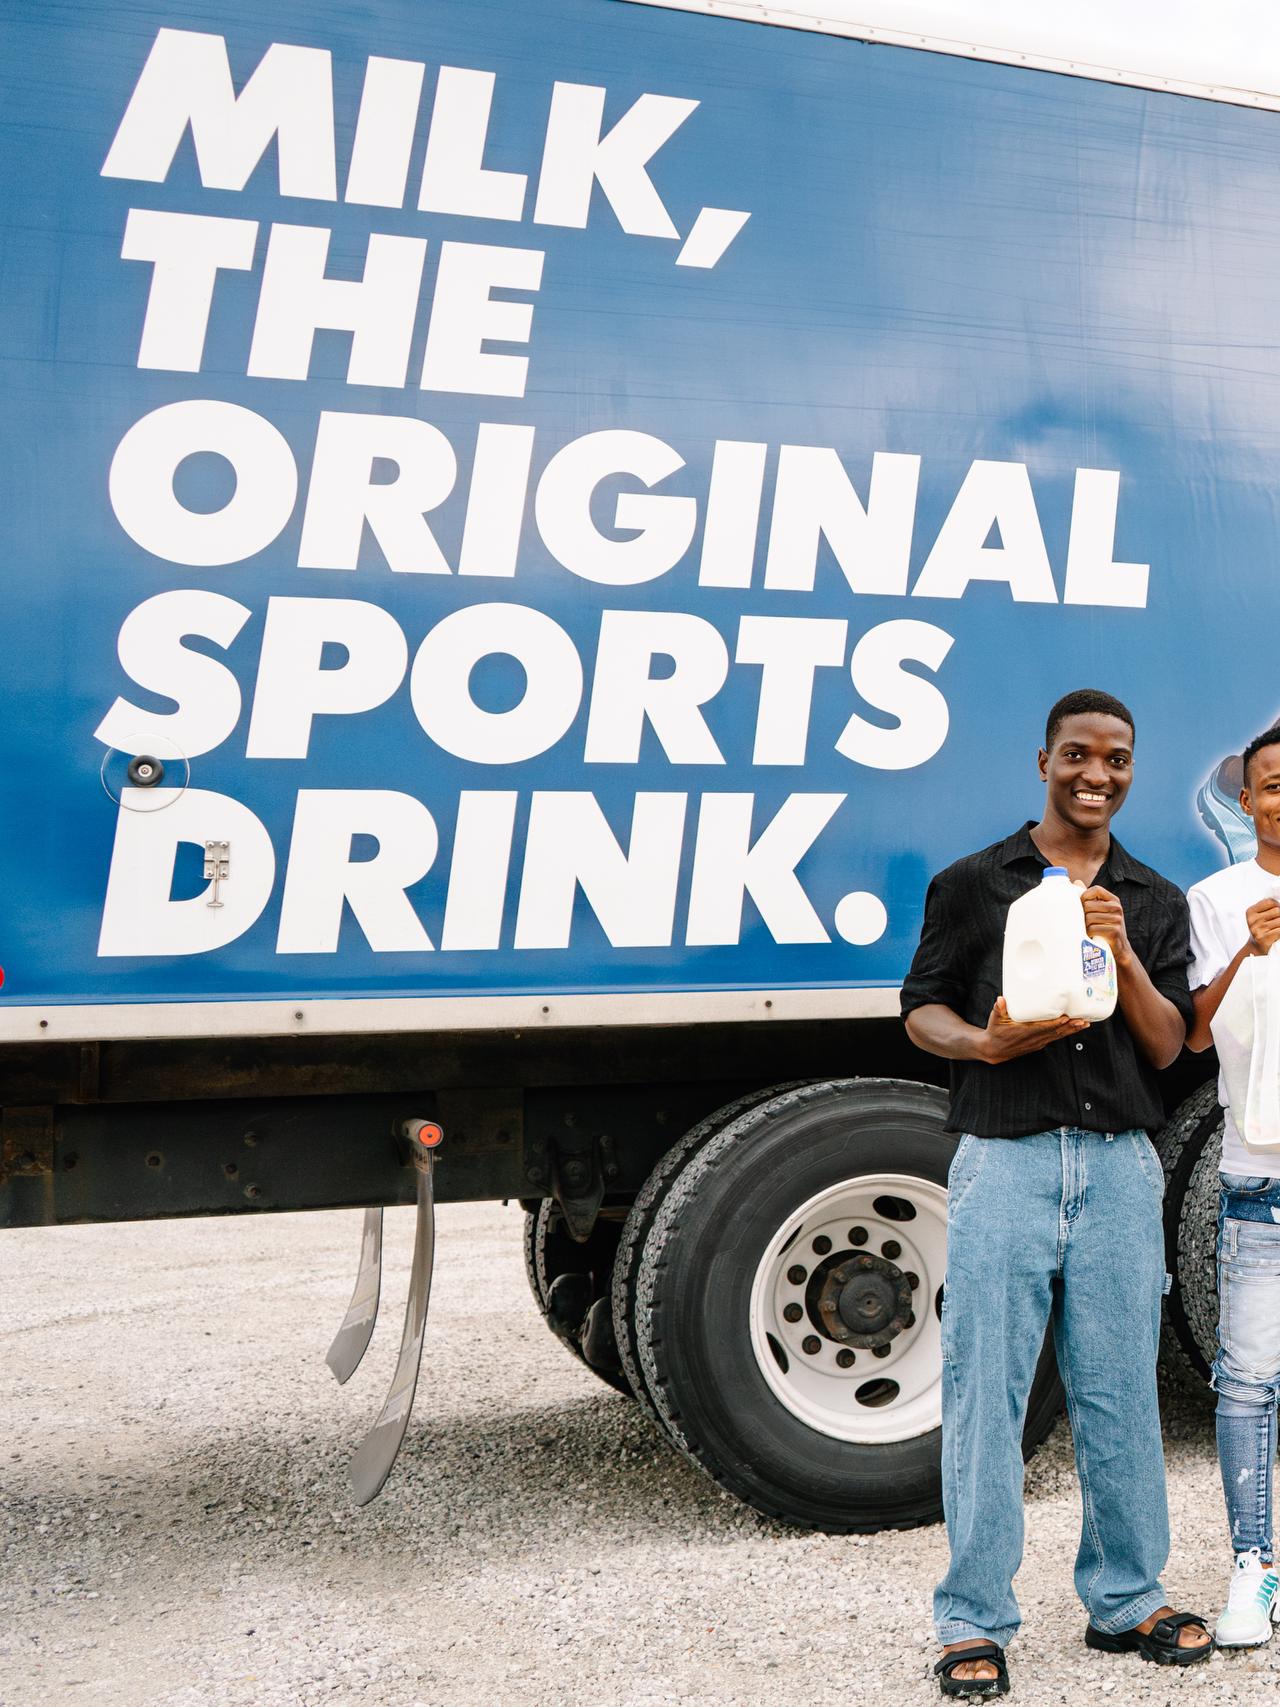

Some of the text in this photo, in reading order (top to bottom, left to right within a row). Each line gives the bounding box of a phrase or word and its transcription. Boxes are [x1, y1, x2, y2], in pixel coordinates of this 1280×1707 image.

[101, 28, 751, 268] MILK,
[121, 209, 545, 398] THE
[109, 400, 1150, 608] ORIGINAL
[94, 590, 954, 769] SPORTS
[98, 788, 887, 956] DRINK.
